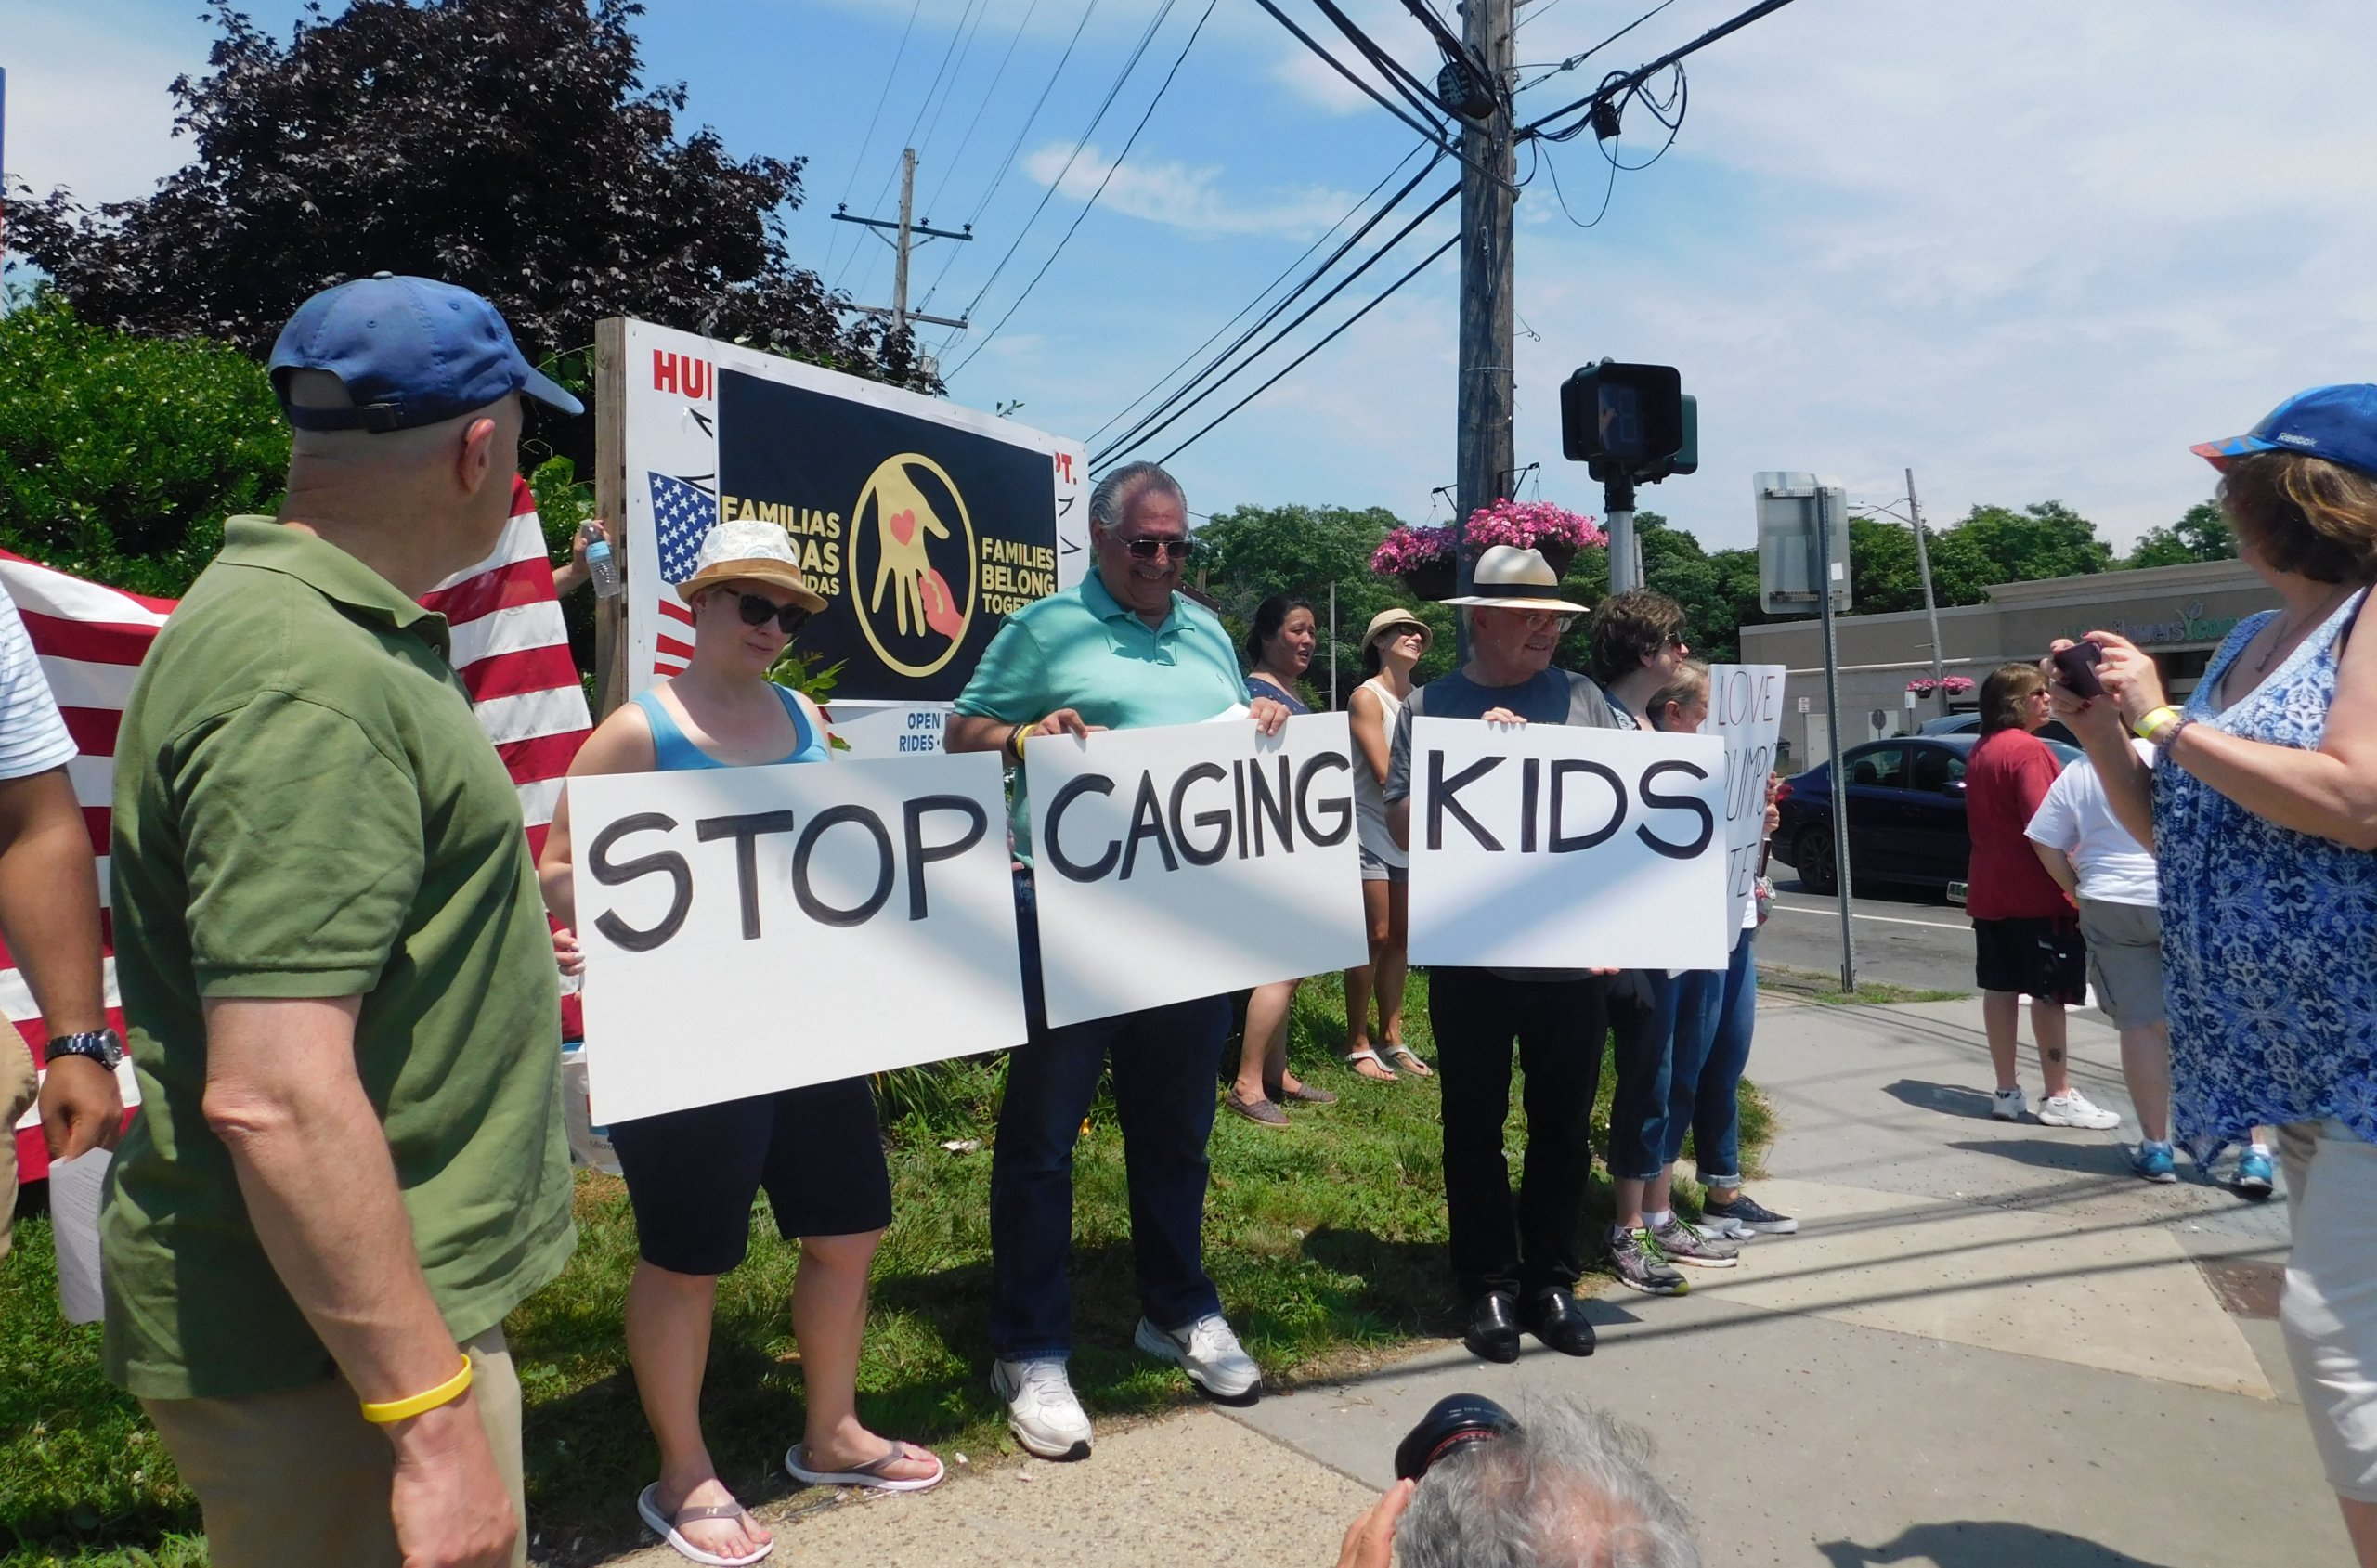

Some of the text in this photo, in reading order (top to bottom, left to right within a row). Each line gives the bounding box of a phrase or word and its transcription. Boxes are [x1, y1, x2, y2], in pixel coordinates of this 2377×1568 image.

[2277, 432, 2318, 447] Reebok
[721, 495, 841, 539] FAMILIAS
[981, 537, 1055, 571] FAMILIES
[981, 564, 1056, 597] BELONG
[1718, 670, 1775, 726] LOVE
[907, 712, 940, 730] OPEN
[899, 734, 934, 752] RIDES
[1045, 750, 1352, 883] CAGING
[1428, 748, 1714, 860] KIDS
[588, 794, 988, 952] STOP
